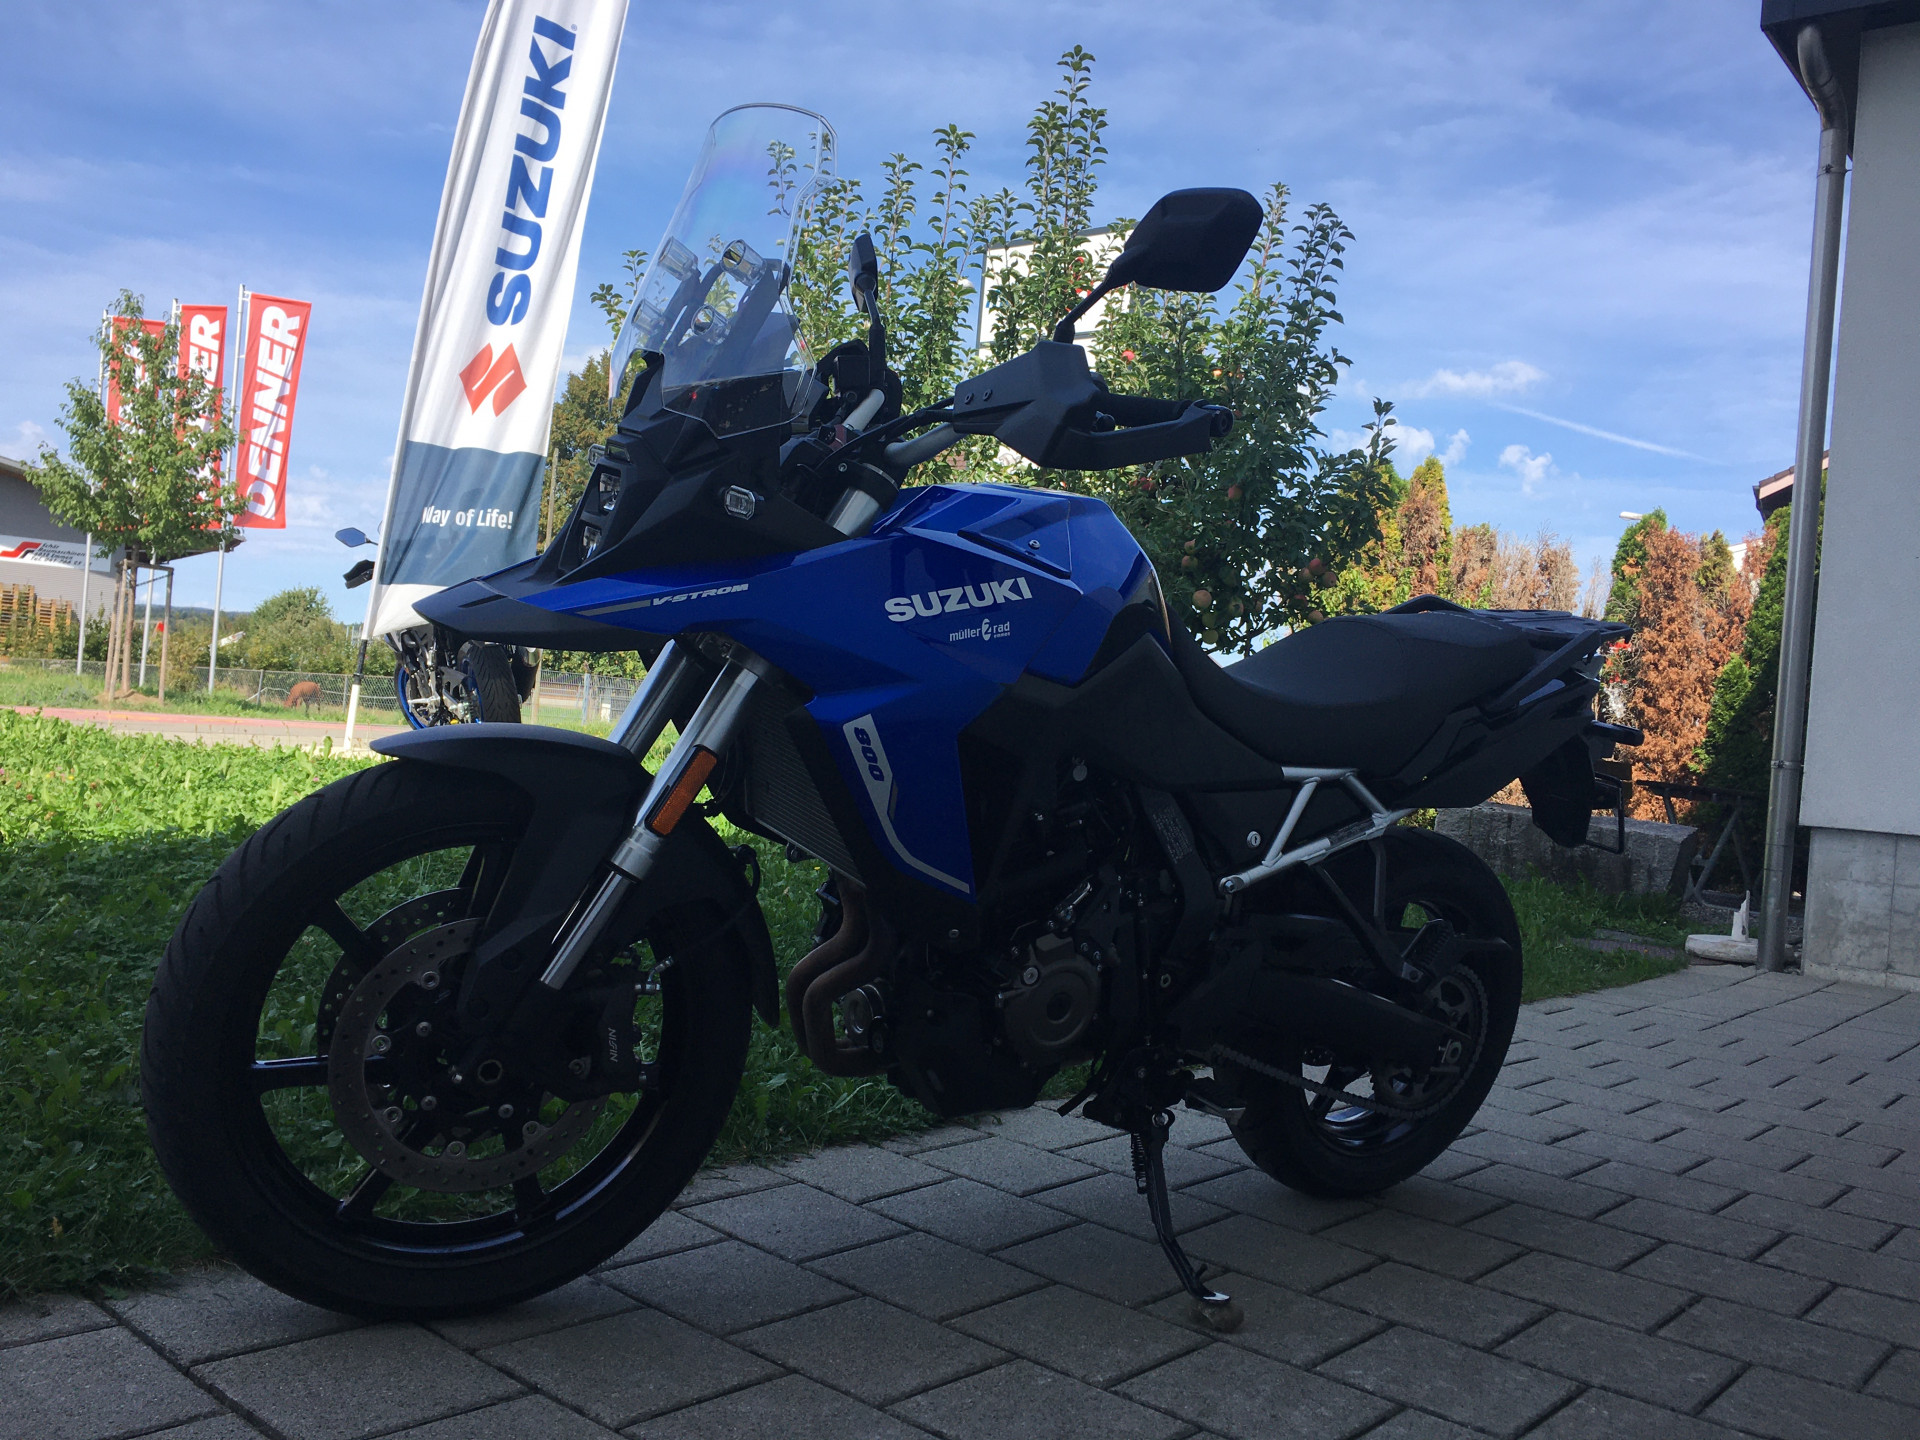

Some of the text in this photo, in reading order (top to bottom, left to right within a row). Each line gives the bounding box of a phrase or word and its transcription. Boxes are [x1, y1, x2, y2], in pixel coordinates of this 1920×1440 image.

[487, 15, 577, 326] SUZUKI
[246, 305, 300, 520] DENNER
[455, 508, 475, 527] of
[476, 508, 514, 530] Life!
[652, 583, 749, 606] V-STROM
[884, 576, 1033, 622] SUZUKI
[949, 628, 982, 642] müller
[854, 726, 885, 782] 800
[608, 1027, 618, 1063] NISSIN
